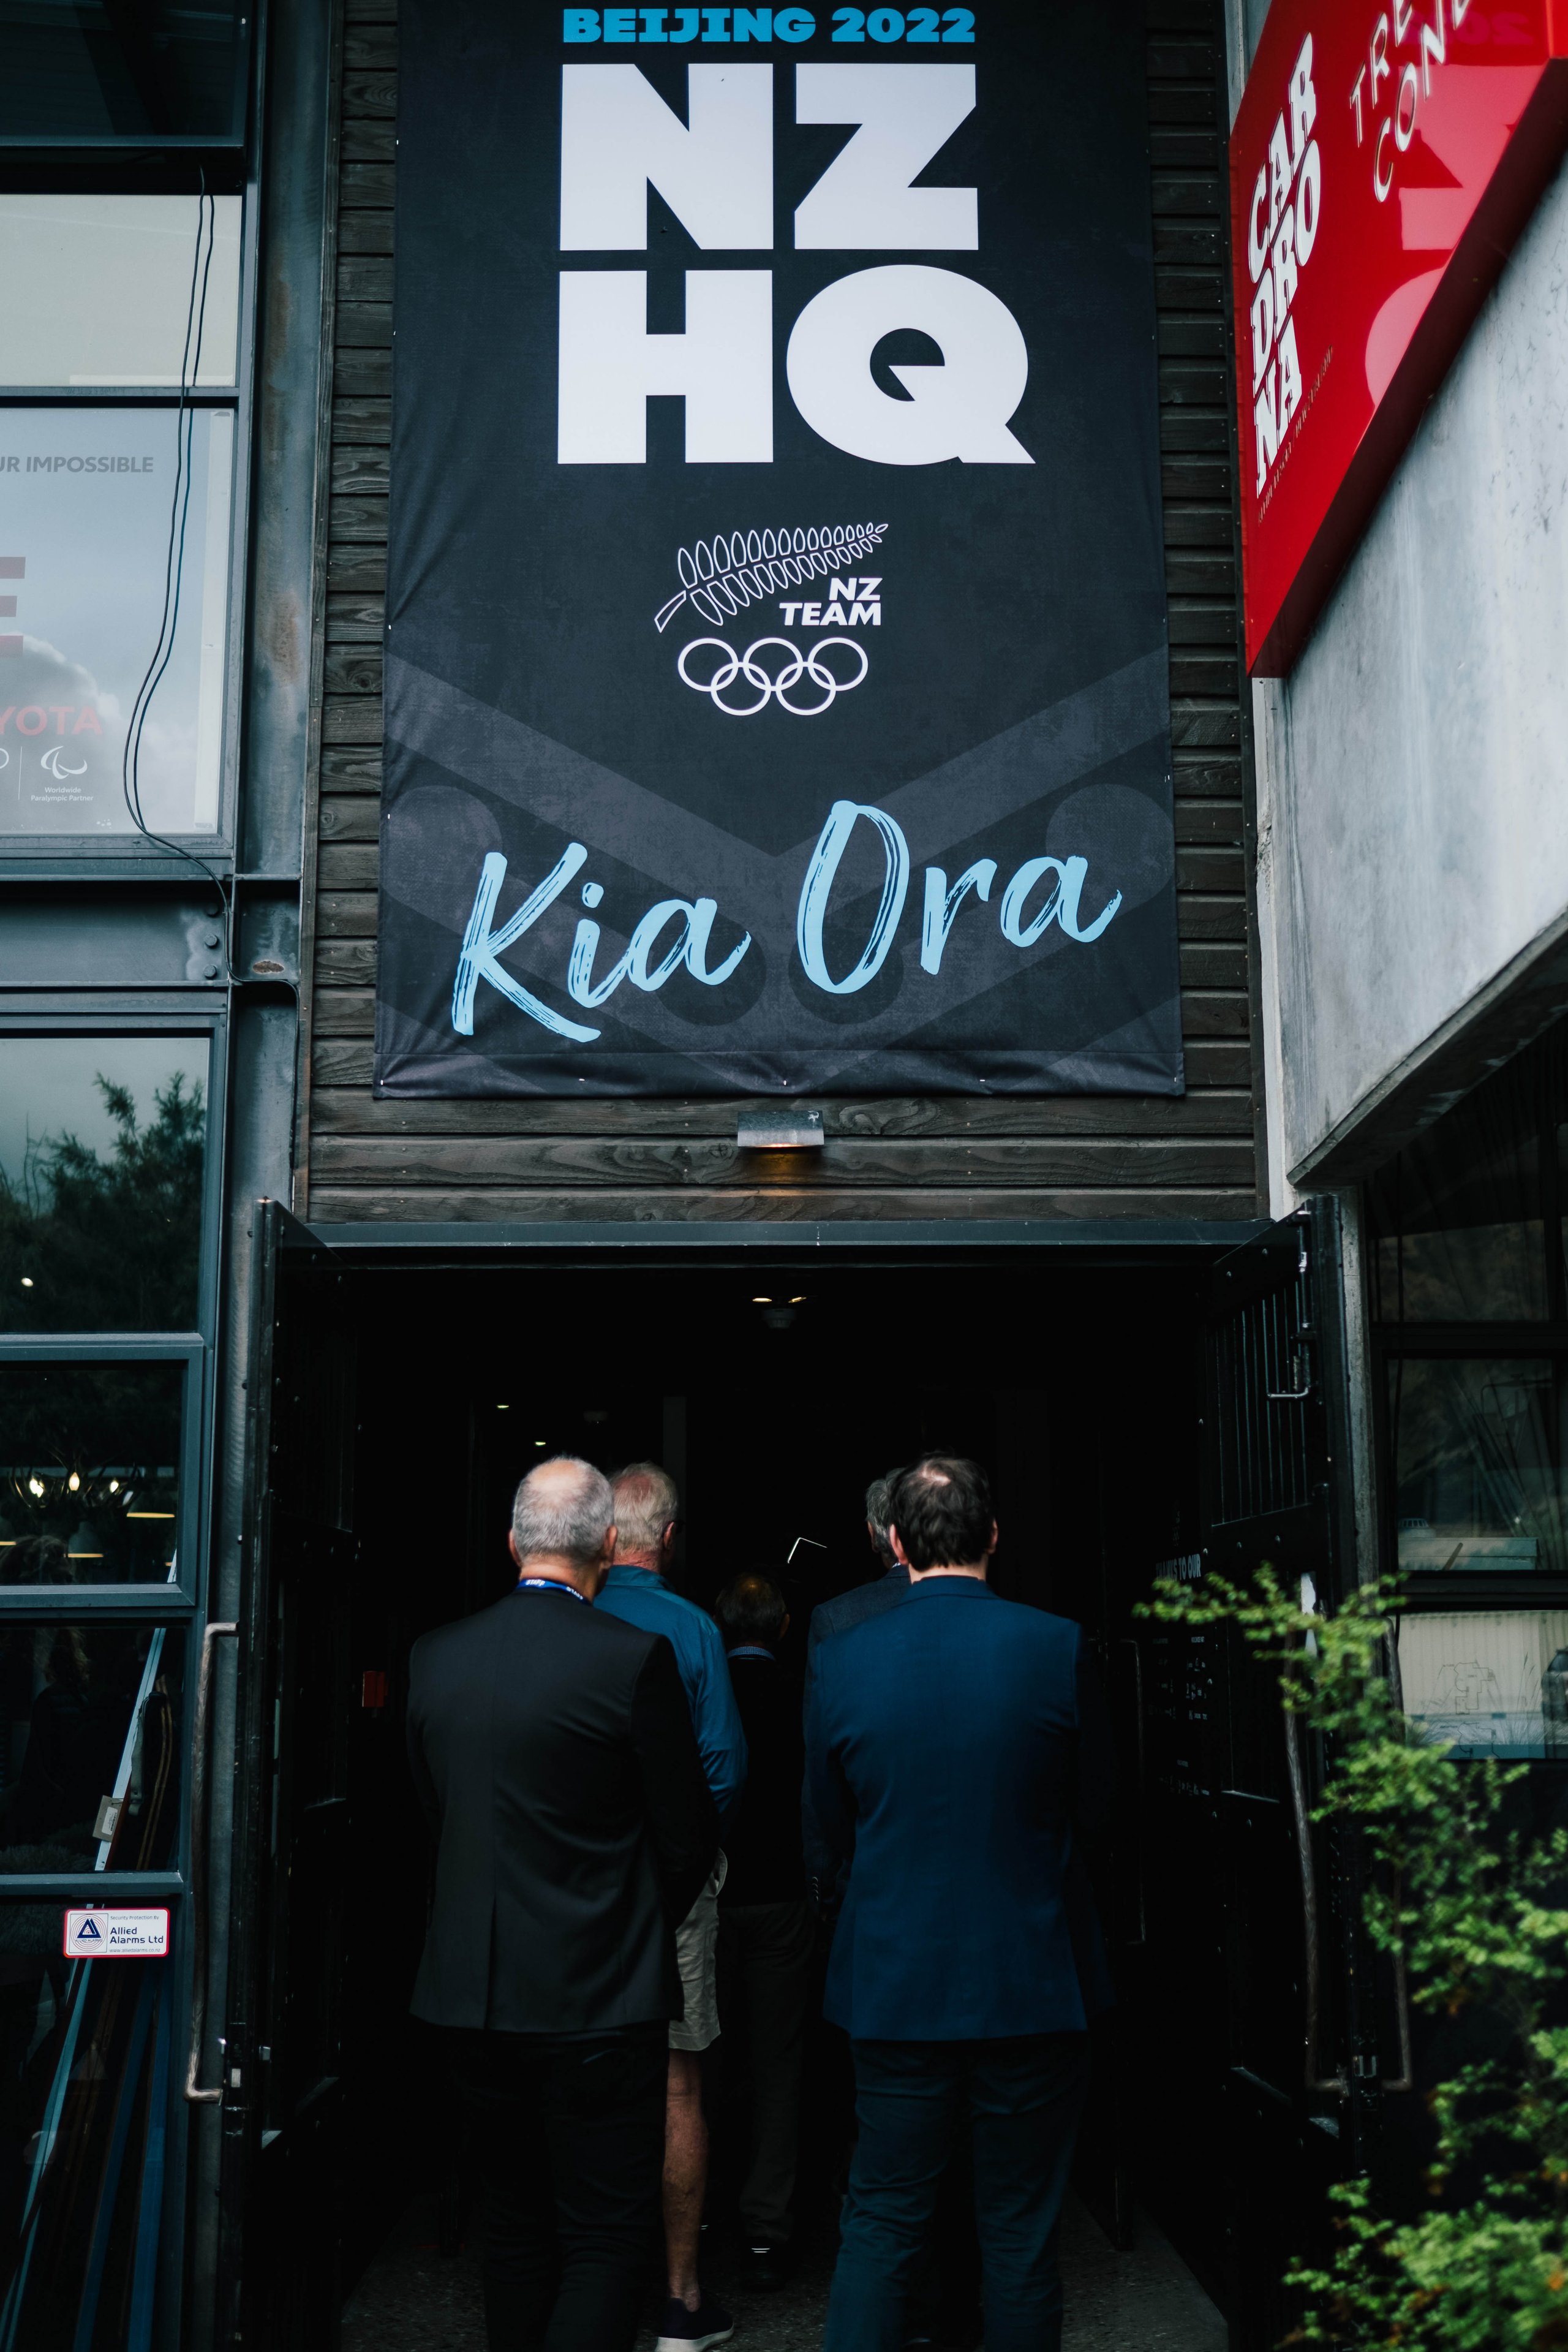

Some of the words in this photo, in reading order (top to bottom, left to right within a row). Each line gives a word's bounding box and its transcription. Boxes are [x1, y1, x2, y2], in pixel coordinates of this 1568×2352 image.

[563, 7, 816, 43] BEIJING
[831, 7, 976, 43] 2022
[560, 63, 979, 251] NZ
[1249, 31, 1316, 284] CAR
[1251, 139, 1321, 398] DRO
[557, 265, 1036, 466] HQ
[1254, 313, 1302, 499] NA
[26, 456, 154, 472] IMPOSSIBLE
[779, 602, 881, 626] TEAM
[829, 578, 883, 601] NZ
[452, 842, 751, 1043] Kia
[796, 800, 1122, 994] Ora
[1178, 1556, 1186, 1581] TO
[1187, 1553, 1202, 1579] OUR
